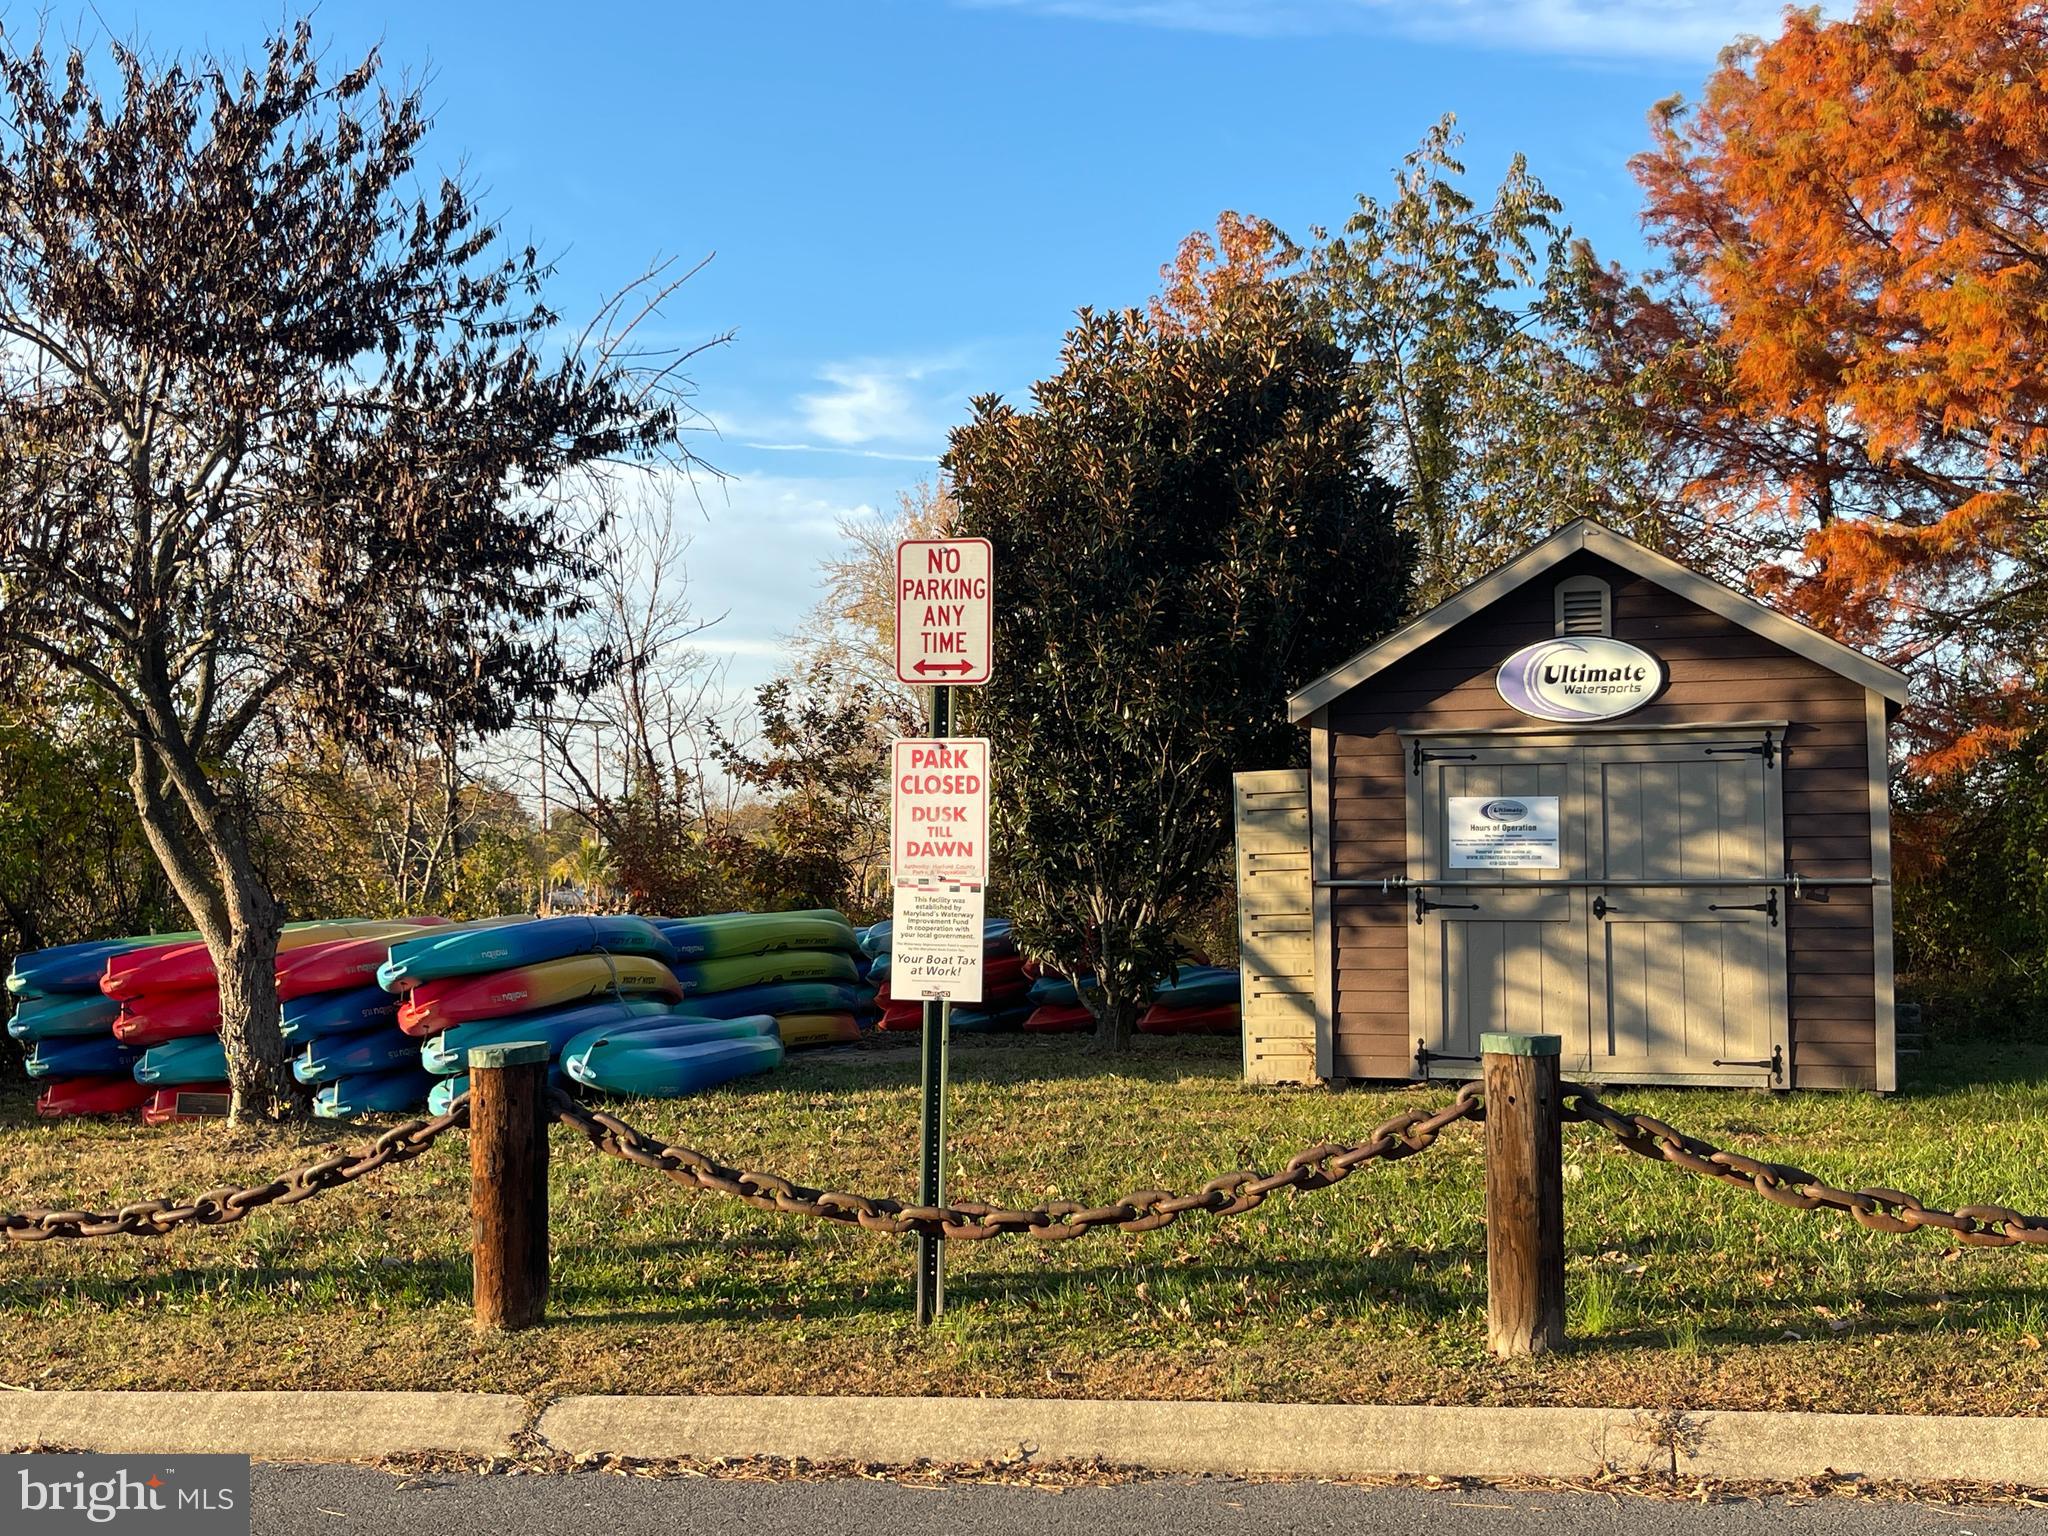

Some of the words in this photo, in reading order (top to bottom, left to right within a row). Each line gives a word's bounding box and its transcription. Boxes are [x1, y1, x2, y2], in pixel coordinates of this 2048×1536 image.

[928, 548, 960, 574] NO
[903, 578, 986, 600] PARKING
[923, 605, 965, 626] ANY
[921, 632, 967, 653] TIME
[1544, 663, 1646, 684] Ultimate
[1564, 684, 1641, 695] Watersports
[911, 750, 968, 768] PARK
[900, 775, 980, 794] CLOSED
[912, 806, 968, 822] DUSK
[927, 826, 953, 838] TILL
[1502, 824, 1537, 832] Operation
[907, 842, 973, 857] DAWN
[903, 910, 939, 918] Maryland's
[481, 949, 508, 959] malibu
[898, 954, 924, 964] Your
[926, 955, 953, 964] Boat
[957, 956, 976, 965] Tax
[910, 967, 923, 975] at
[926, 966, 962, 976] Work!
[502, 991, 527, 1001] malibu
